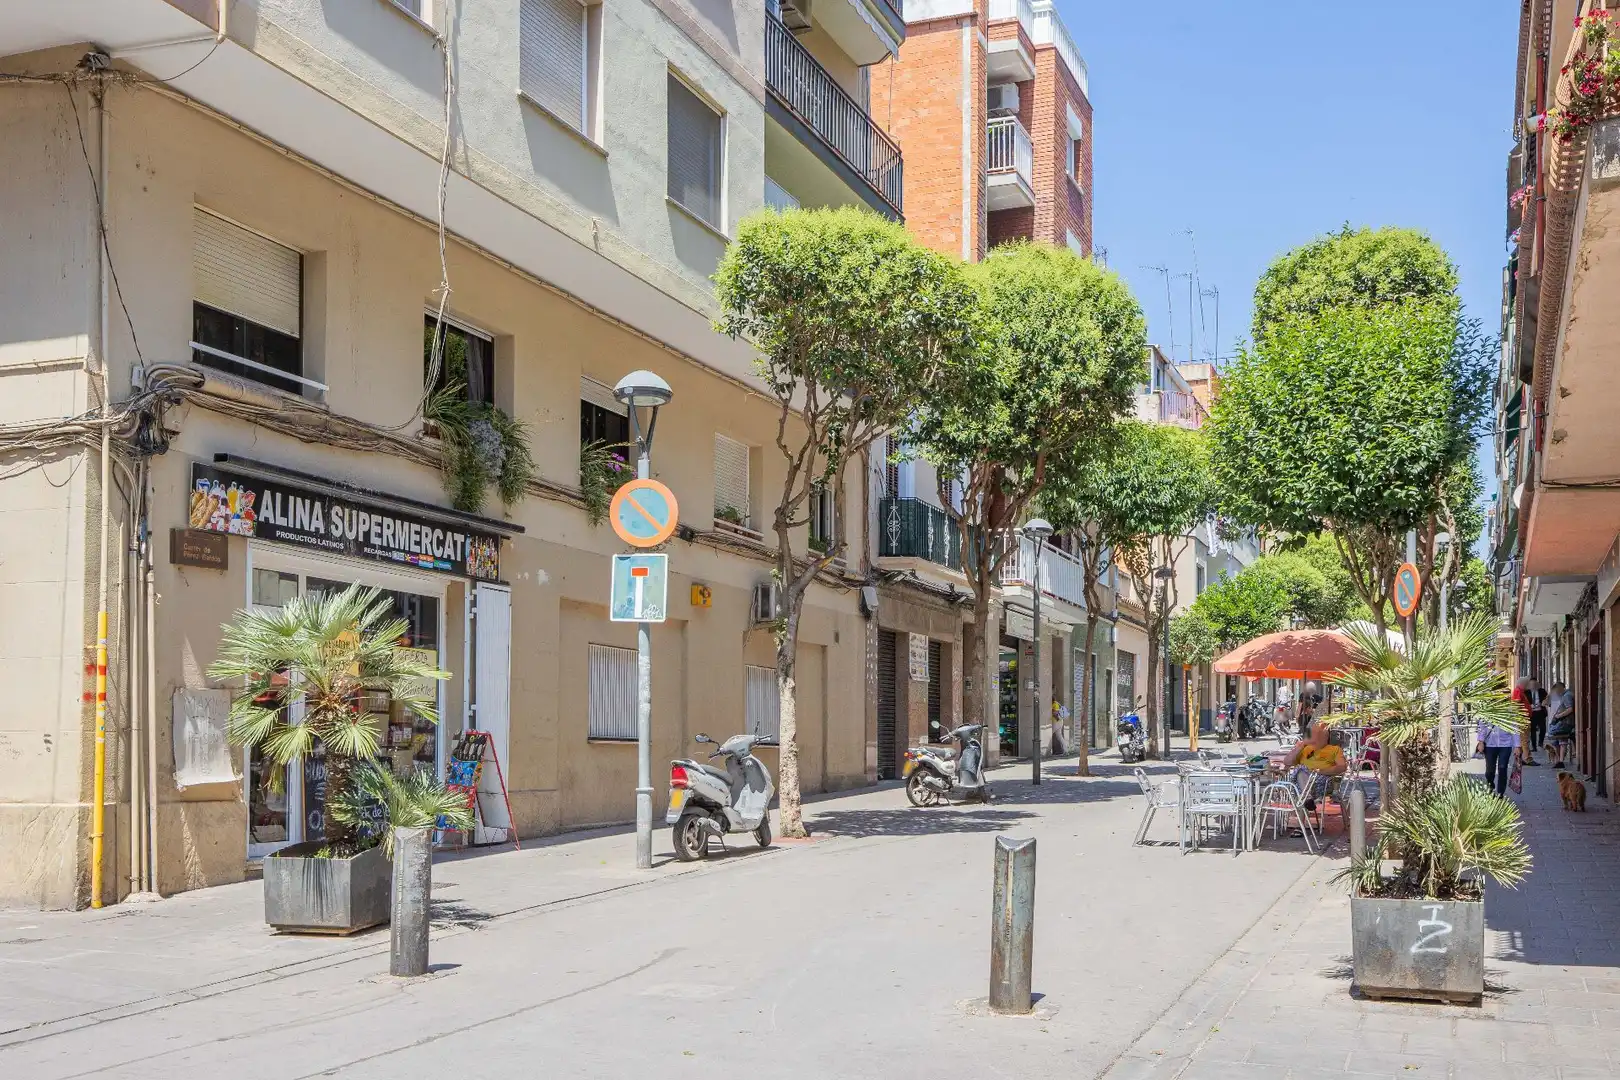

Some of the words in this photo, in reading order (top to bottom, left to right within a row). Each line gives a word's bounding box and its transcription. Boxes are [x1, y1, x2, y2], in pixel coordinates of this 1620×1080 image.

[259, 489, 325, 533] ALINA
[330, 505, 465, 562] SUPERMERCAT
[275, 530, 317, 544] PRODUCTOS
[317, 539, 345, 550] LATINOS
[363, 546, 392, 558] RECARGAS
